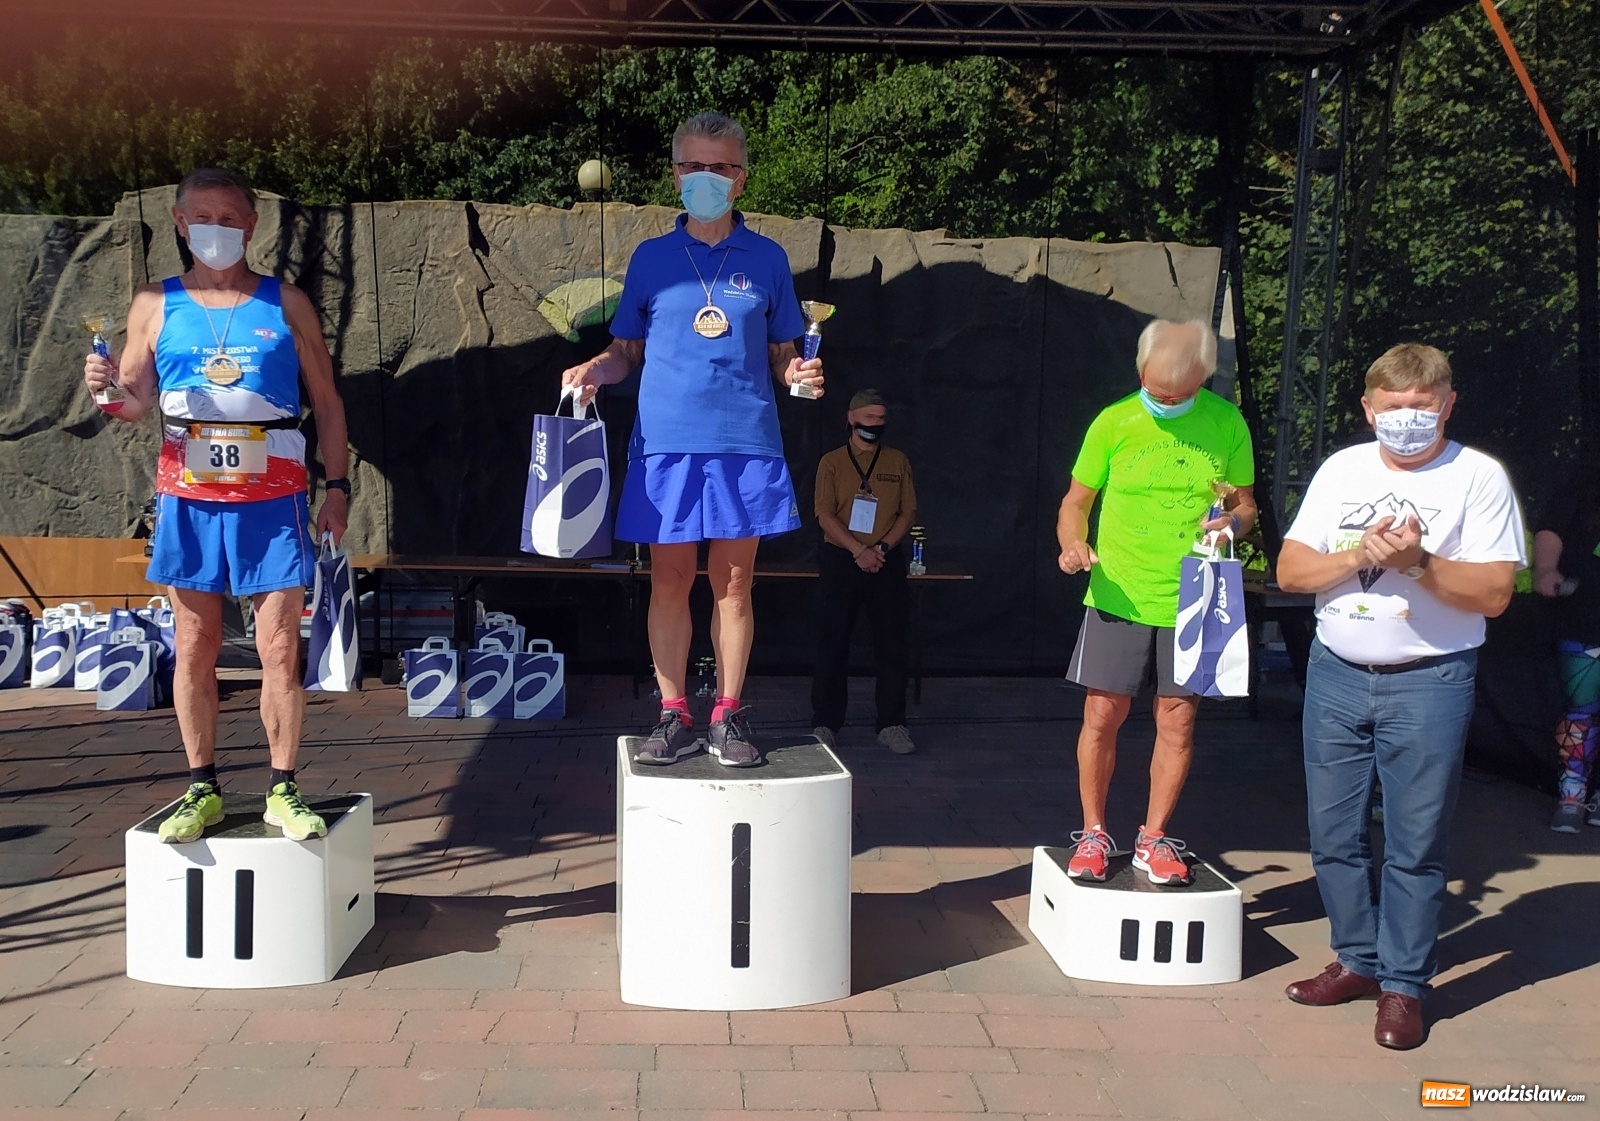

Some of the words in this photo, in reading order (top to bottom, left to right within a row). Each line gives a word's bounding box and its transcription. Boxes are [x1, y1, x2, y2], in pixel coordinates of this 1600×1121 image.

[191, 346, 200, 354] 7.
[202, 345, 259, 355] MISTZOSTWA
[209, 444, 240, 468] 38
[535, 431, 547, 465] asics
[1217, 577, 1227, 609] asics
[1349, 613, 1375, 621] Brenna
